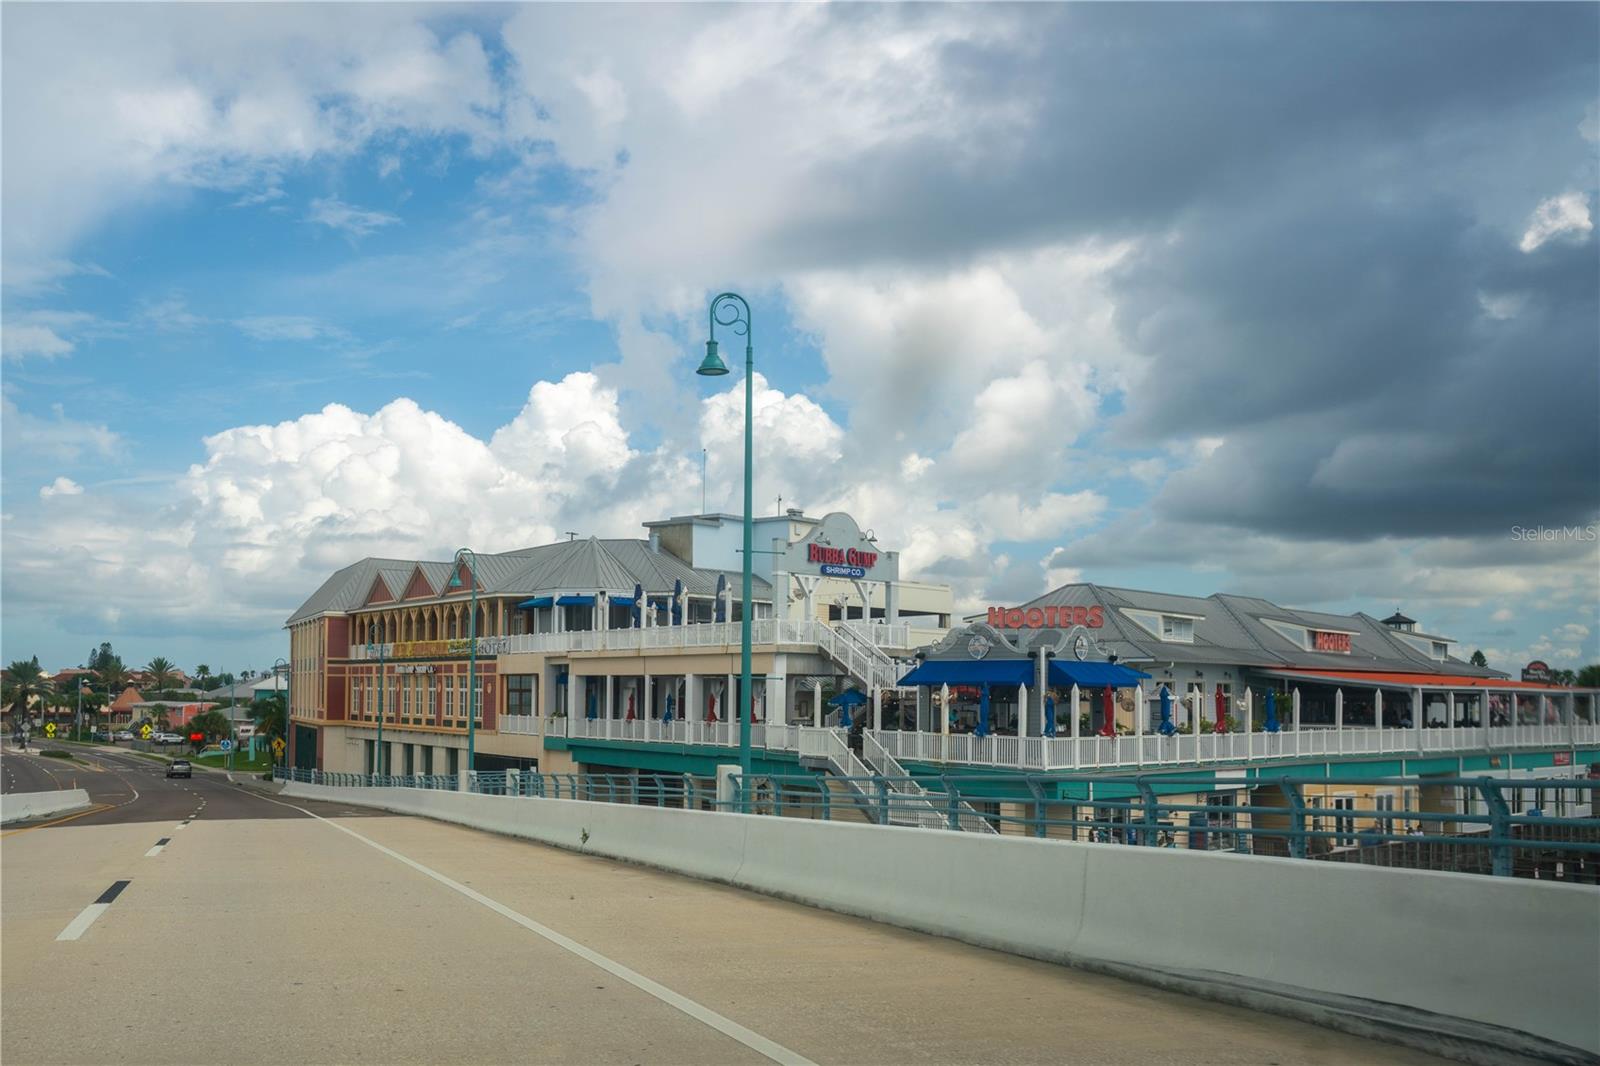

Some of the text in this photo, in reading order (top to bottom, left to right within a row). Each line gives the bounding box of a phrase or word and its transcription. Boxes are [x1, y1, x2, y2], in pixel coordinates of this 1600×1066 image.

[808, 543, 878, 568] BUBBA GUMP
[826, 566, 850, 575] SHRIMP
[987, 605, 1104, 629] HOOTERS
[1316, 631, 1351, 651] HOOTERS
